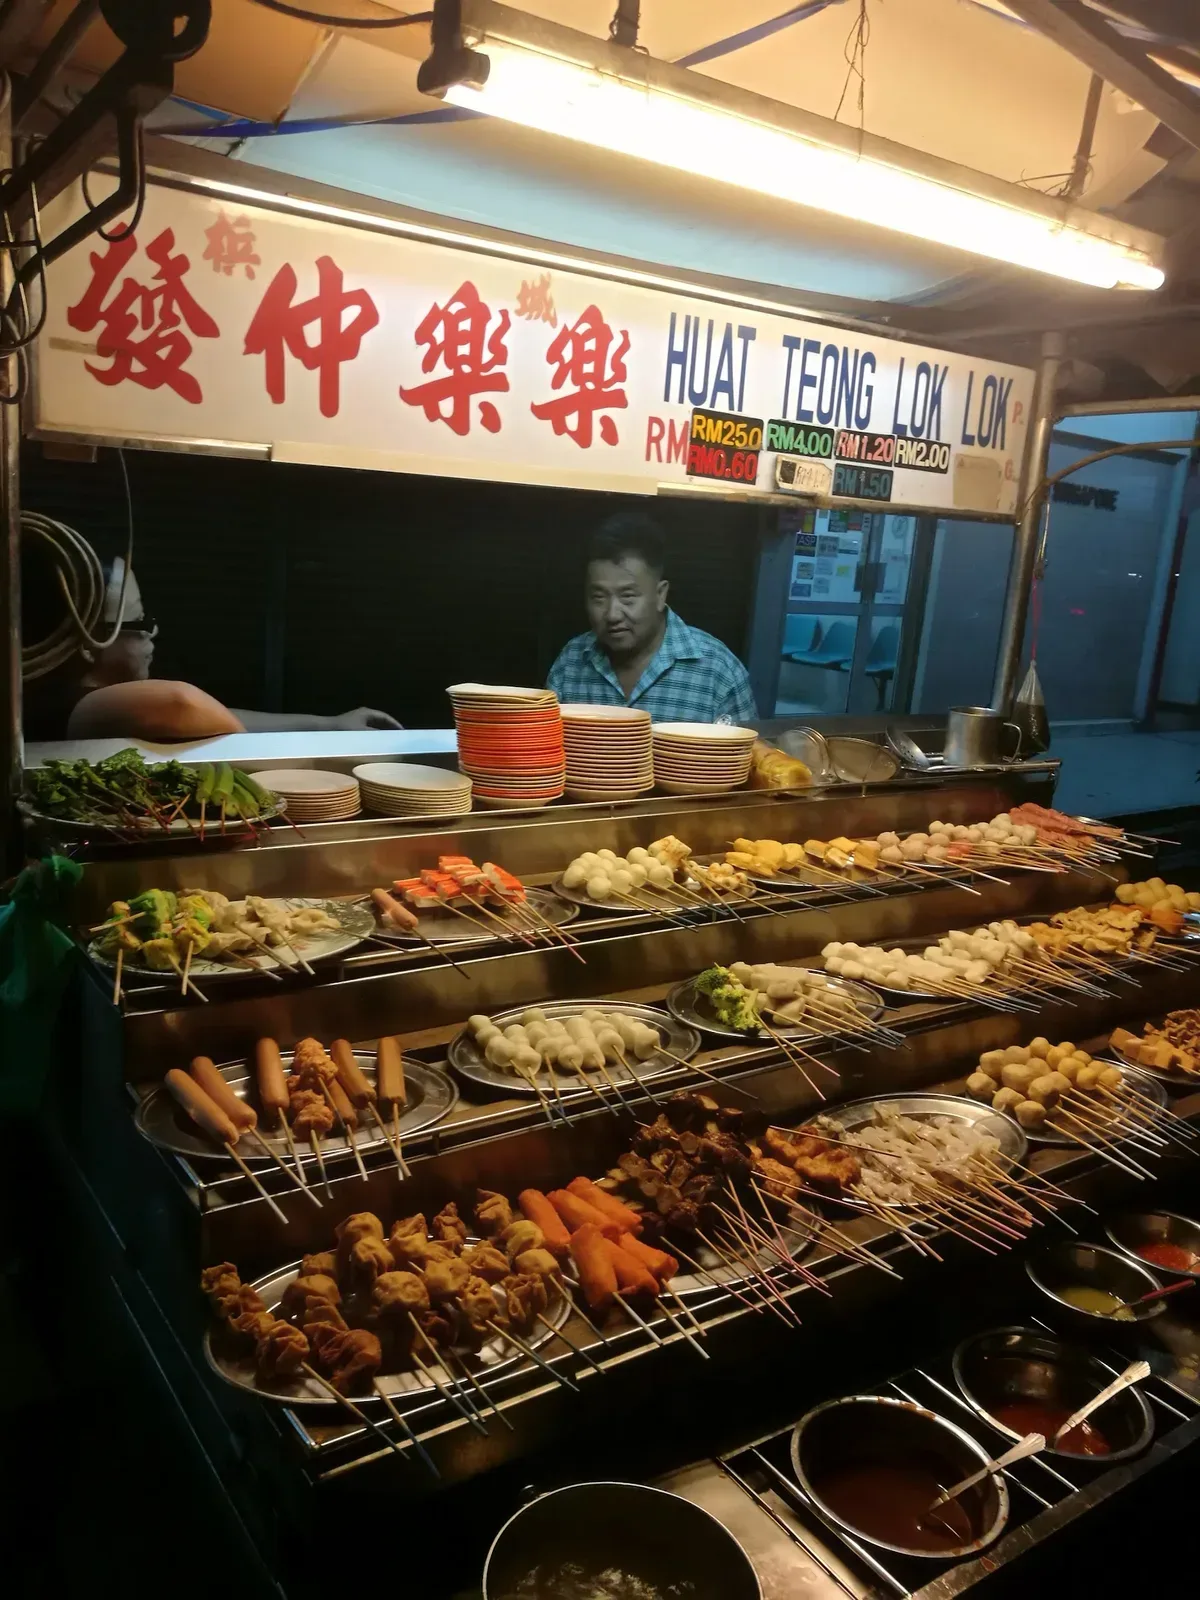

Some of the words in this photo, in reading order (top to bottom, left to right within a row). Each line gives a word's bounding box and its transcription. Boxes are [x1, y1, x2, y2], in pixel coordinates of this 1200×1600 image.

[664, 312, 757, 412] HUAT
[782, 334, 877, 430] TEONG
[892, 357, 949, 441] LOK
[961, 370, 1013, 450] LOK
[767, 423, 832, 457] RM4.00
[836, 431, 895, 463] RM1.20
[895, 439, 950, 470] RM2.00
[687, 444, 758, 480] RM0.60
